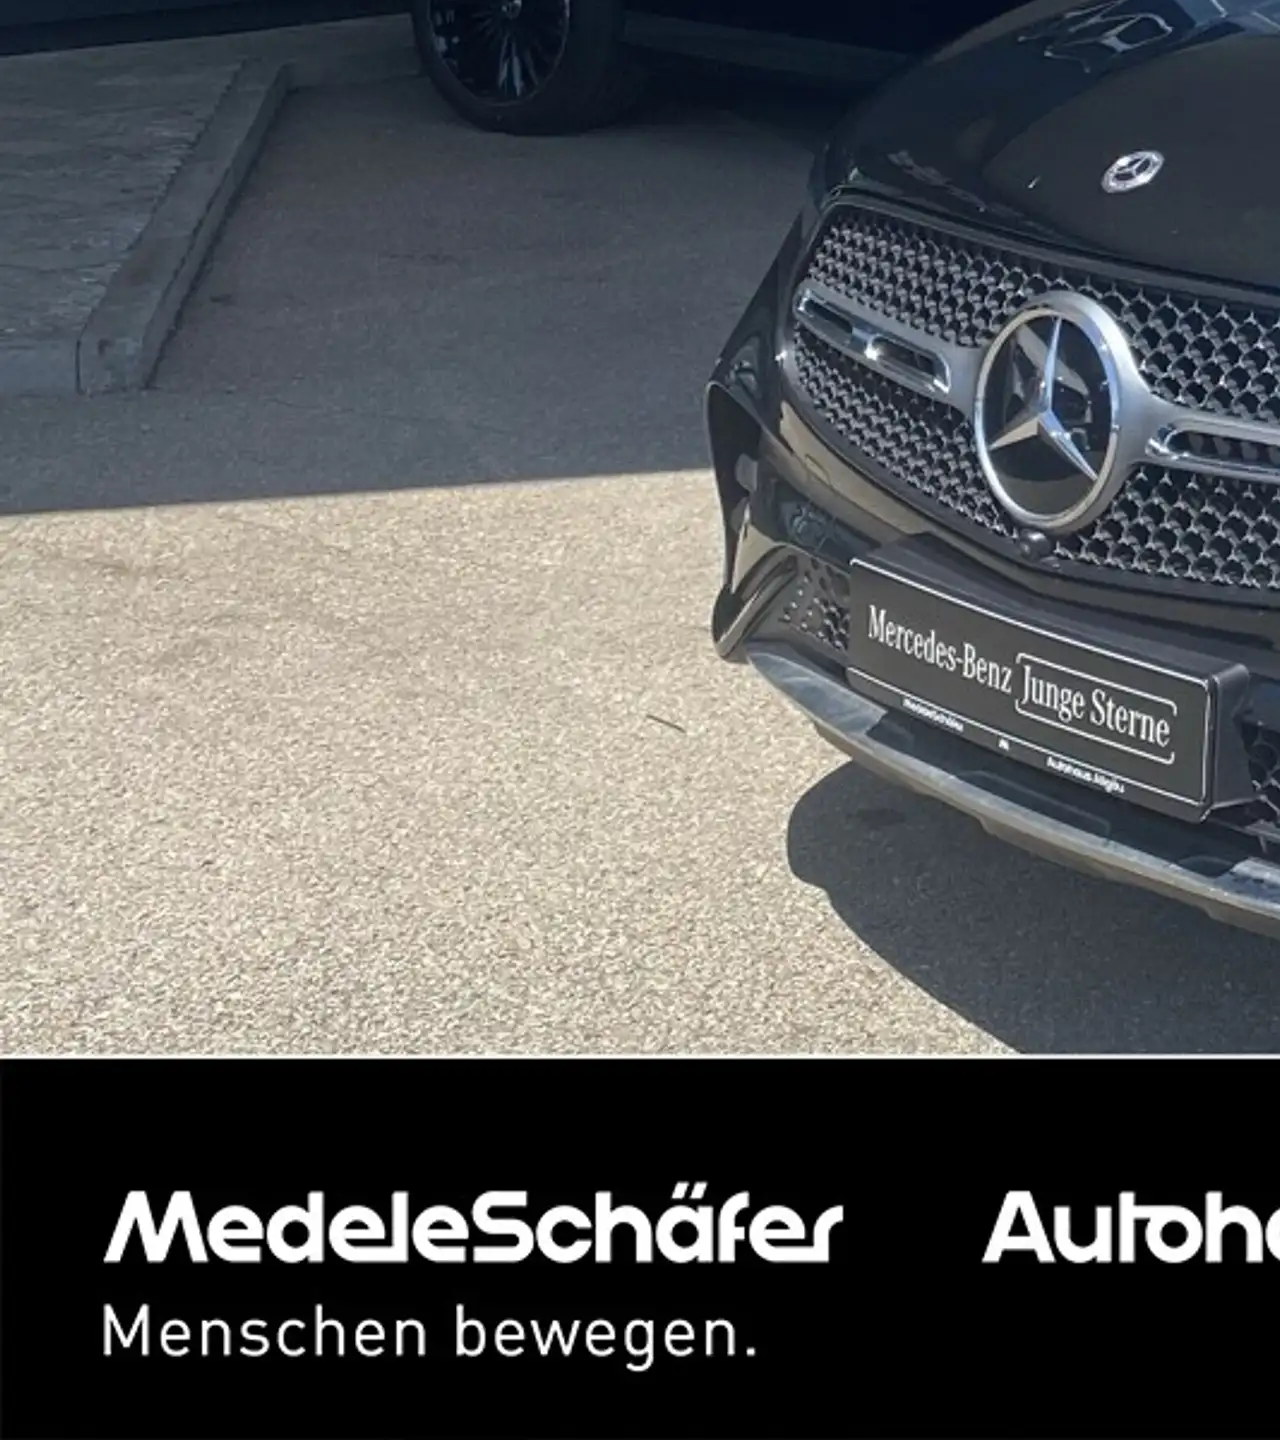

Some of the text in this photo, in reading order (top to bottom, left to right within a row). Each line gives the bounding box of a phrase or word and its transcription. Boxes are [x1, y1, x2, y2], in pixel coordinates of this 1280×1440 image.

[868, 605, 1012, 693] Mercedes-Benz
[1021, 665, 1086, 723] Junge
[1090, 688, 1171, 747] Sterne
